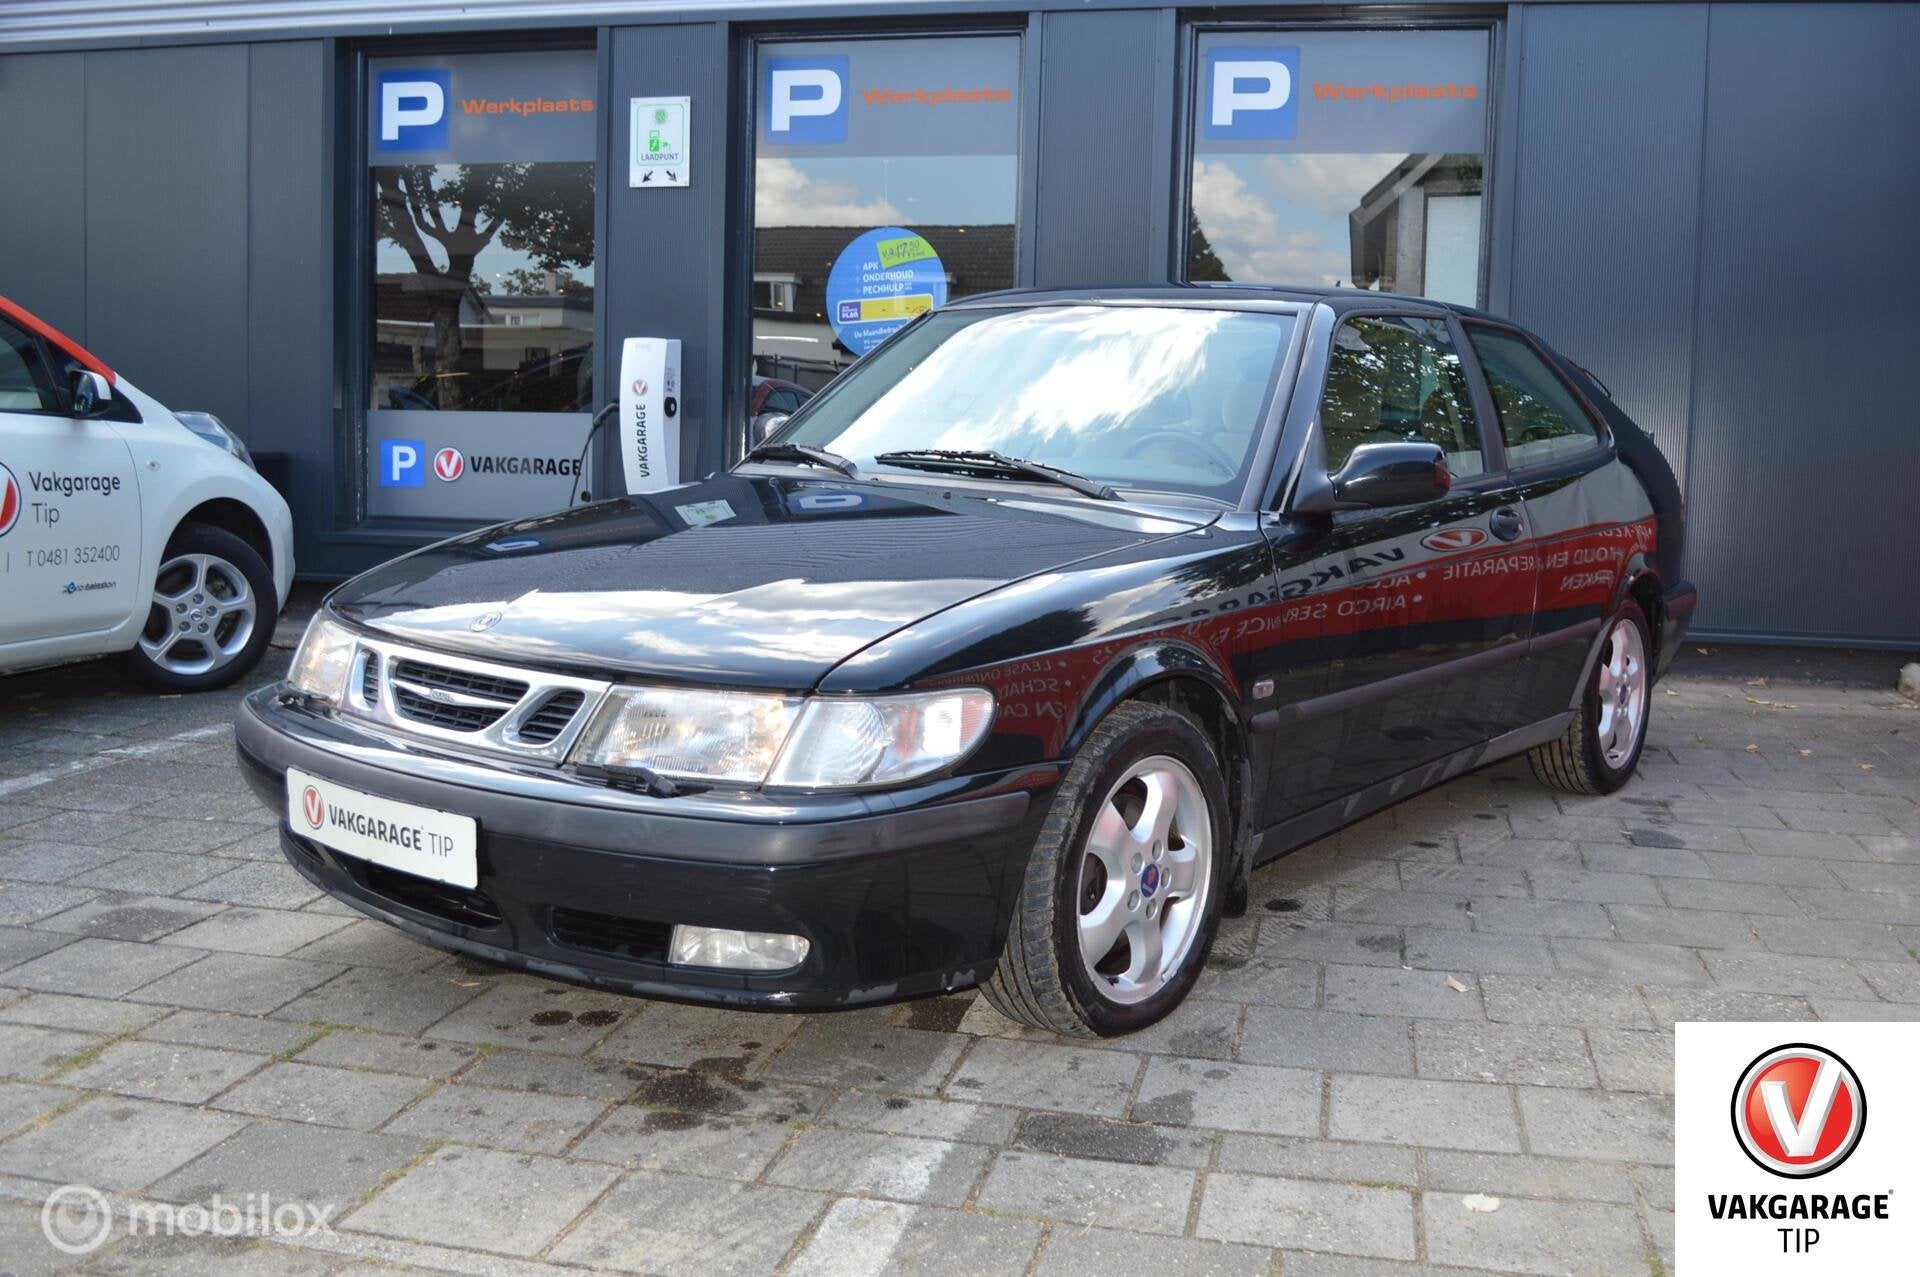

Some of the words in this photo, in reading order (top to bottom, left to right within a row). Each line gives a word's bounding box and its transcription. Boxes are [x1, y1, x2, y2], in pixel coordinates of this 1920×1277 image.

[771, 69, 842, 131] P
[861, 86, 1012, 107] Werkplaats
[1212, 60, 1291, 126] P
[1312, 81, 1478, 102] Werkplaats
[382, 81, 444, 141] P
[461, 98, 594, 116] Werkplaats
[640, 153, 679, 161] LAADPUNT
[862, 262, 879, 272] APK
[862, 269, 915, 283] ONDERHOUD
[862, 283, 905, 295] PECHHULP
[863, 325, 900, 337] Maandbedra
[636, 403, 650, 478] VAKGARAGE
[392, 445, 416, 482] P
[470, 455, 581, 477] VAKGARAGE
[29, 471, 121, 497] Vakgarage
[31, 502, 61, 528] Tip
[37, 548, 68, 567] 0481
[74, 545, 121, 564] 352400
[329, 804, 422, 851] VAKGARAGE
[428, 832, 454, 858] TIP
